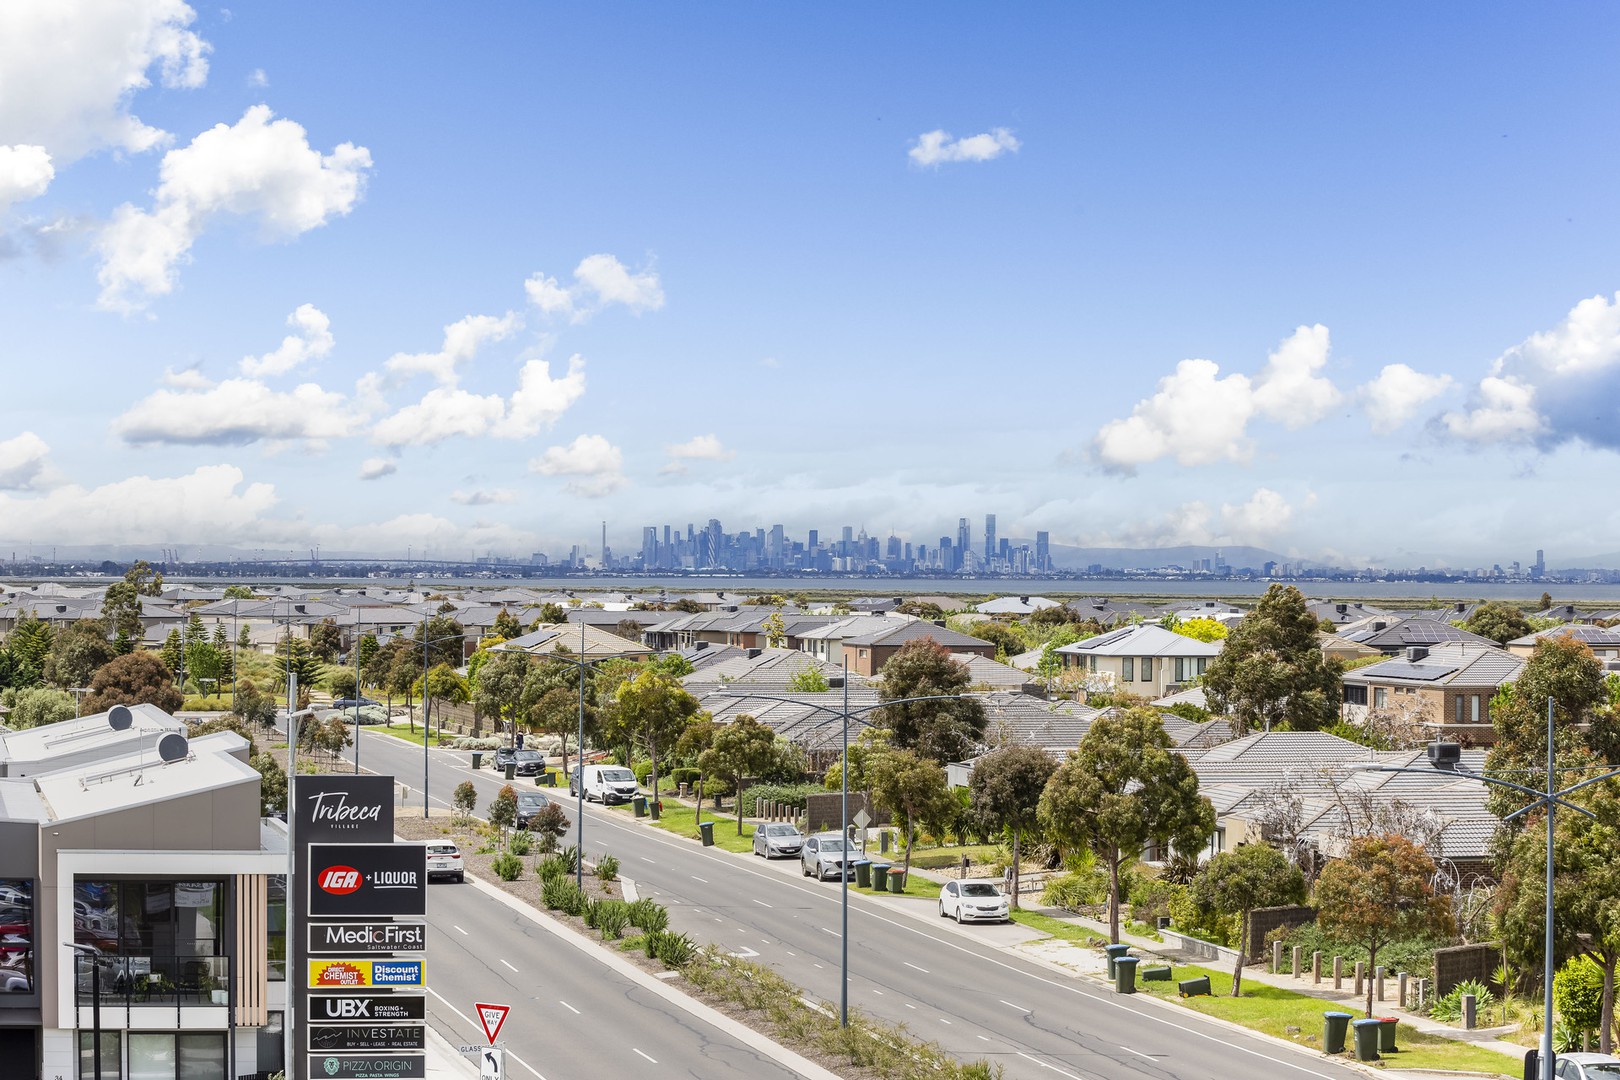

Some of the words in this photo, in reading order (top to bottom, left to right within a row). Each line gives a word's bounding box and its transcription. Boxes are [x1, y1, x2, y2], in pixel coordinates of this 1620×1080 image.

[308, 791, 381, 823] Tribeca
[322, 871, 359, 888] IGA
[374, 871, 417, 884] LIQUOR
[326, 926, 423, 944] MedicFirst
[326, 999, 370, 1017] UBX
[347, 1028, 420, 1038] INVESTATE
[343, 1060, 373, 1071] PIZZA
[374, 1060, 412, 1071] ORIGIN
